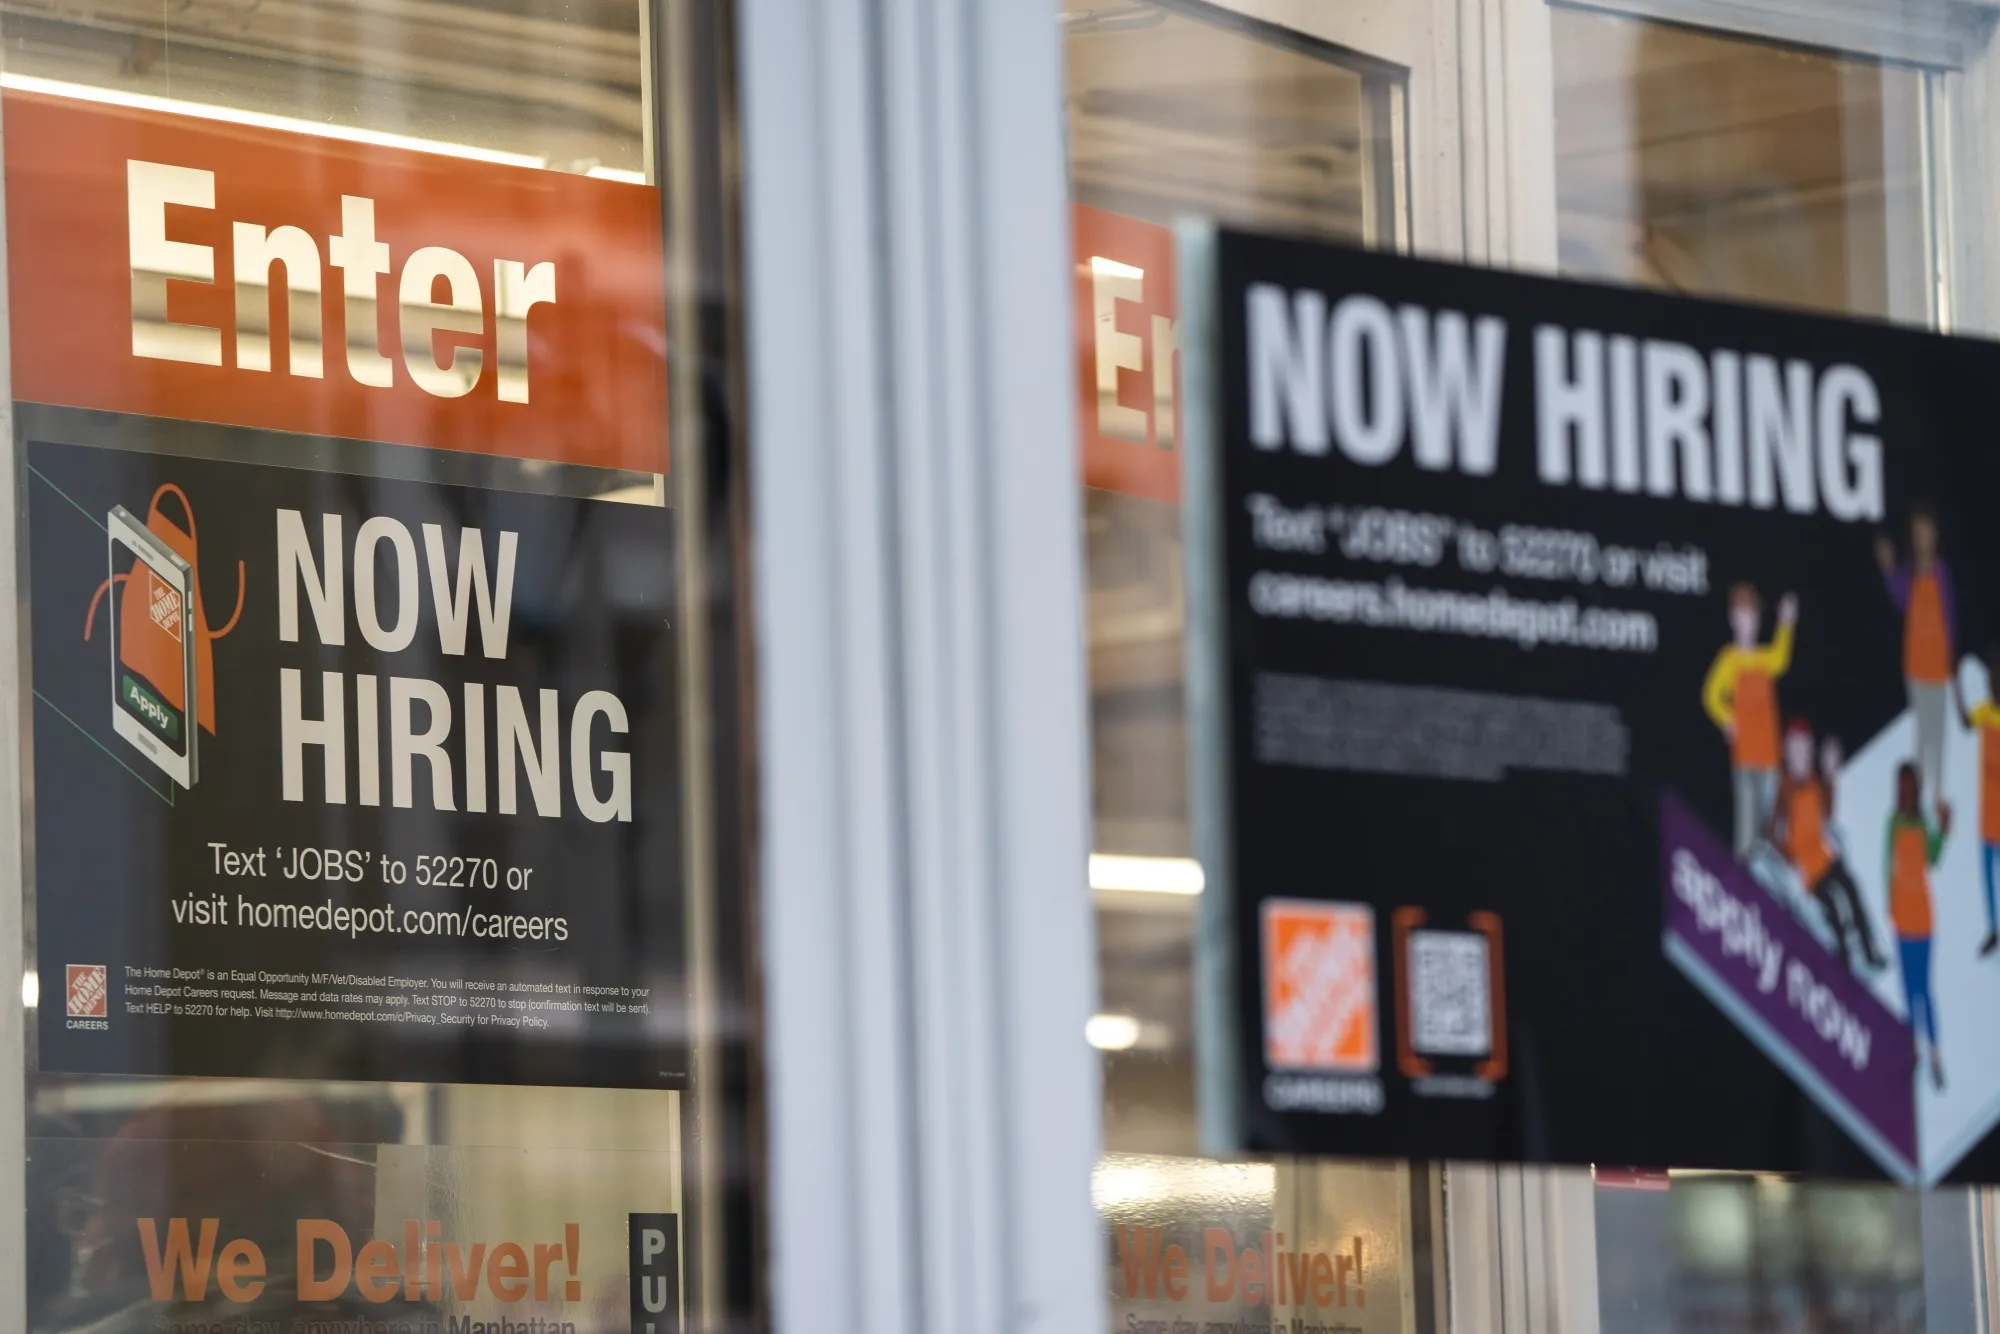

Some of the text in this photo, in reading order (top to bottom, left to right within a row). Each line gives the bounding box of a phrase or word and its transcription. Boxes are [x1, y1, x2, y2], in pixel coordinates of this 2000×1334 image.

[127, 159, 556, 404] Enter
[1246, 284, 1885, 520] NOW HIRING
[277, 509, 518, 659] NOW
[1250, 496, 1324, 552] Text
[1459, 523, 1496, 572] to
[1501, 525, 1598, 582] 52270
[1601, 546, 1636, 585] or
[1643, 544, 1706, 593] visit
[1251, 572, 1656, 650] careers.homedepot.com
[130, 685, 169, 729] Apply
[280, 668, 632, 822] HIRING
[208, 843, 266, 877] Text
[381, 854, 406, 884] to
[416, 855, 497, 889] 52270
[506, 866, 532, 890] or
[172, 892, 568, 941] visit homedepot.com/careers
[1672, 849, 1870, 1069] apply now
[66, 1020, 109, 1030] CAREERS
[125, 966, 141, 978] The
[144, 967, 171, 979] Home
[207, 970, 215, 980] is
[217, 971, 228, 981] an
[231, 970, 257, 983] Equal
[258, 971, 309, 986] Opportunity
[312, 973, 386, 987] M/F/Vet/Disabled
[388, 976, 429, 991] Employer.
[431, 977, 447, 989] You
[449, 978, 463, 990] will
[465, 979, 495, 991] receive
[497, 982, 507, 991] an
[509, 982, 553, 993] automated
[555, 984, 571, 994] text
[573, 983, 581, 994] in
[583, 985, 619, 996] response
[621, 986, 629, 997] to
[632, 988, 650, 999] your
[125, 984, 651, 1016] Home Depot Careers request. Message and data rates may apply. Text STOP to 52270 to stop (confirmation text will be sent).
[125, 1002, 549, 1029] Text HELP to 52270 for help. Visit http://www.homedepot.com/c/Privacy_Security for Privacy Policy.
[137, 1217, 581, 1303] We Deliver!
[642, 1229, 667, 1334] PU
[1116, 1223, 1365, 1308] We Deliver!
